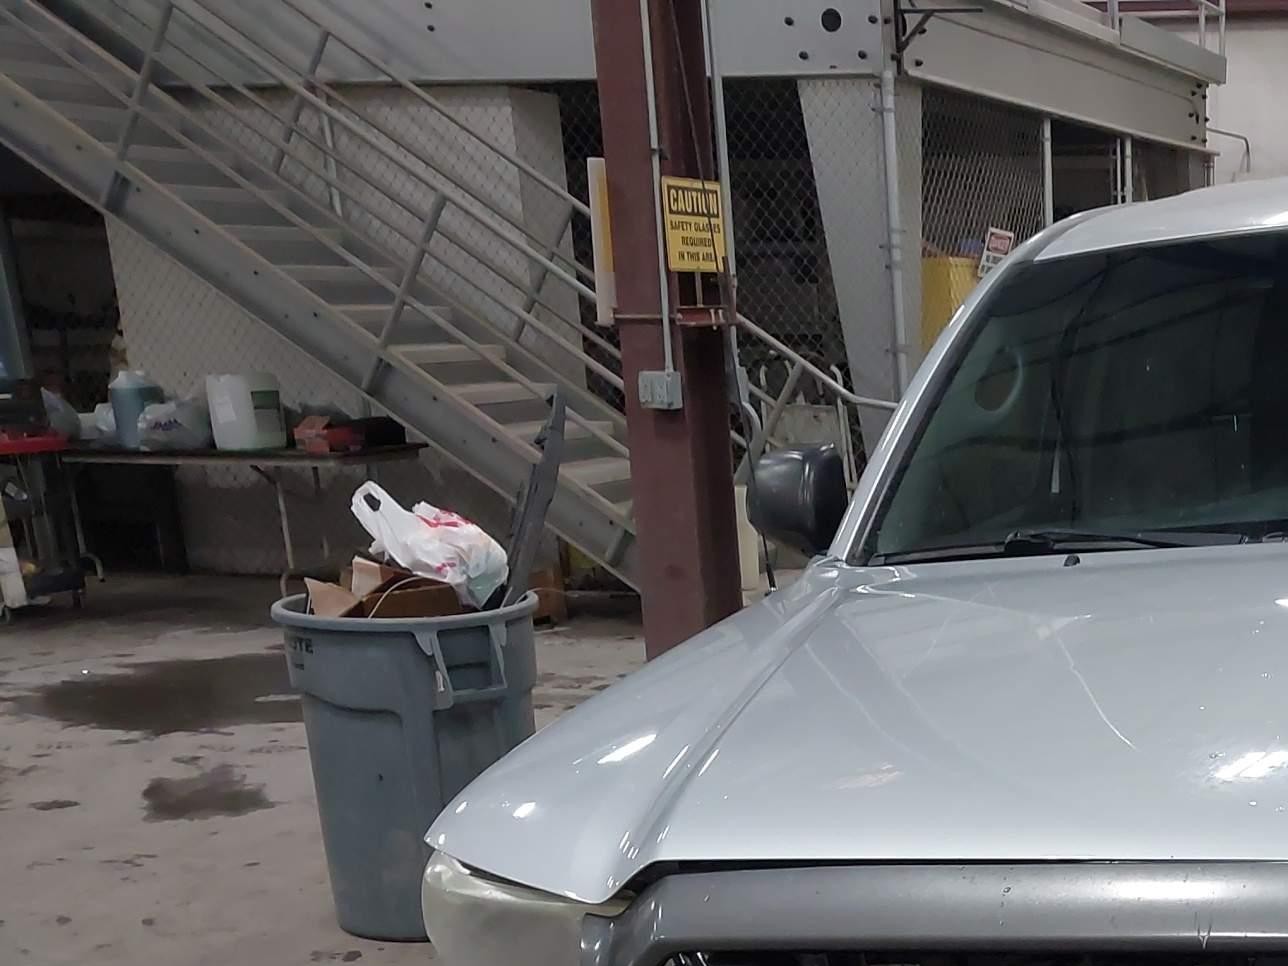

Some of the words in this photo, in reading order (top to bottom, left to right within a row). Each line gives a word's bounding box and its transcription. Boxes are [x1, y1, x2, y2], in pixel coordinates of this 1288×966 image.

[670, 220, 692, 232] SAFETY
[694, 222, 721, 234] GLASES
[681, 236, 712, 247] REQUIRED
[678, 250, 685, 260] IN
[687, 251, 700, 262] THIS
[702, 252, 717, 262] ARE
